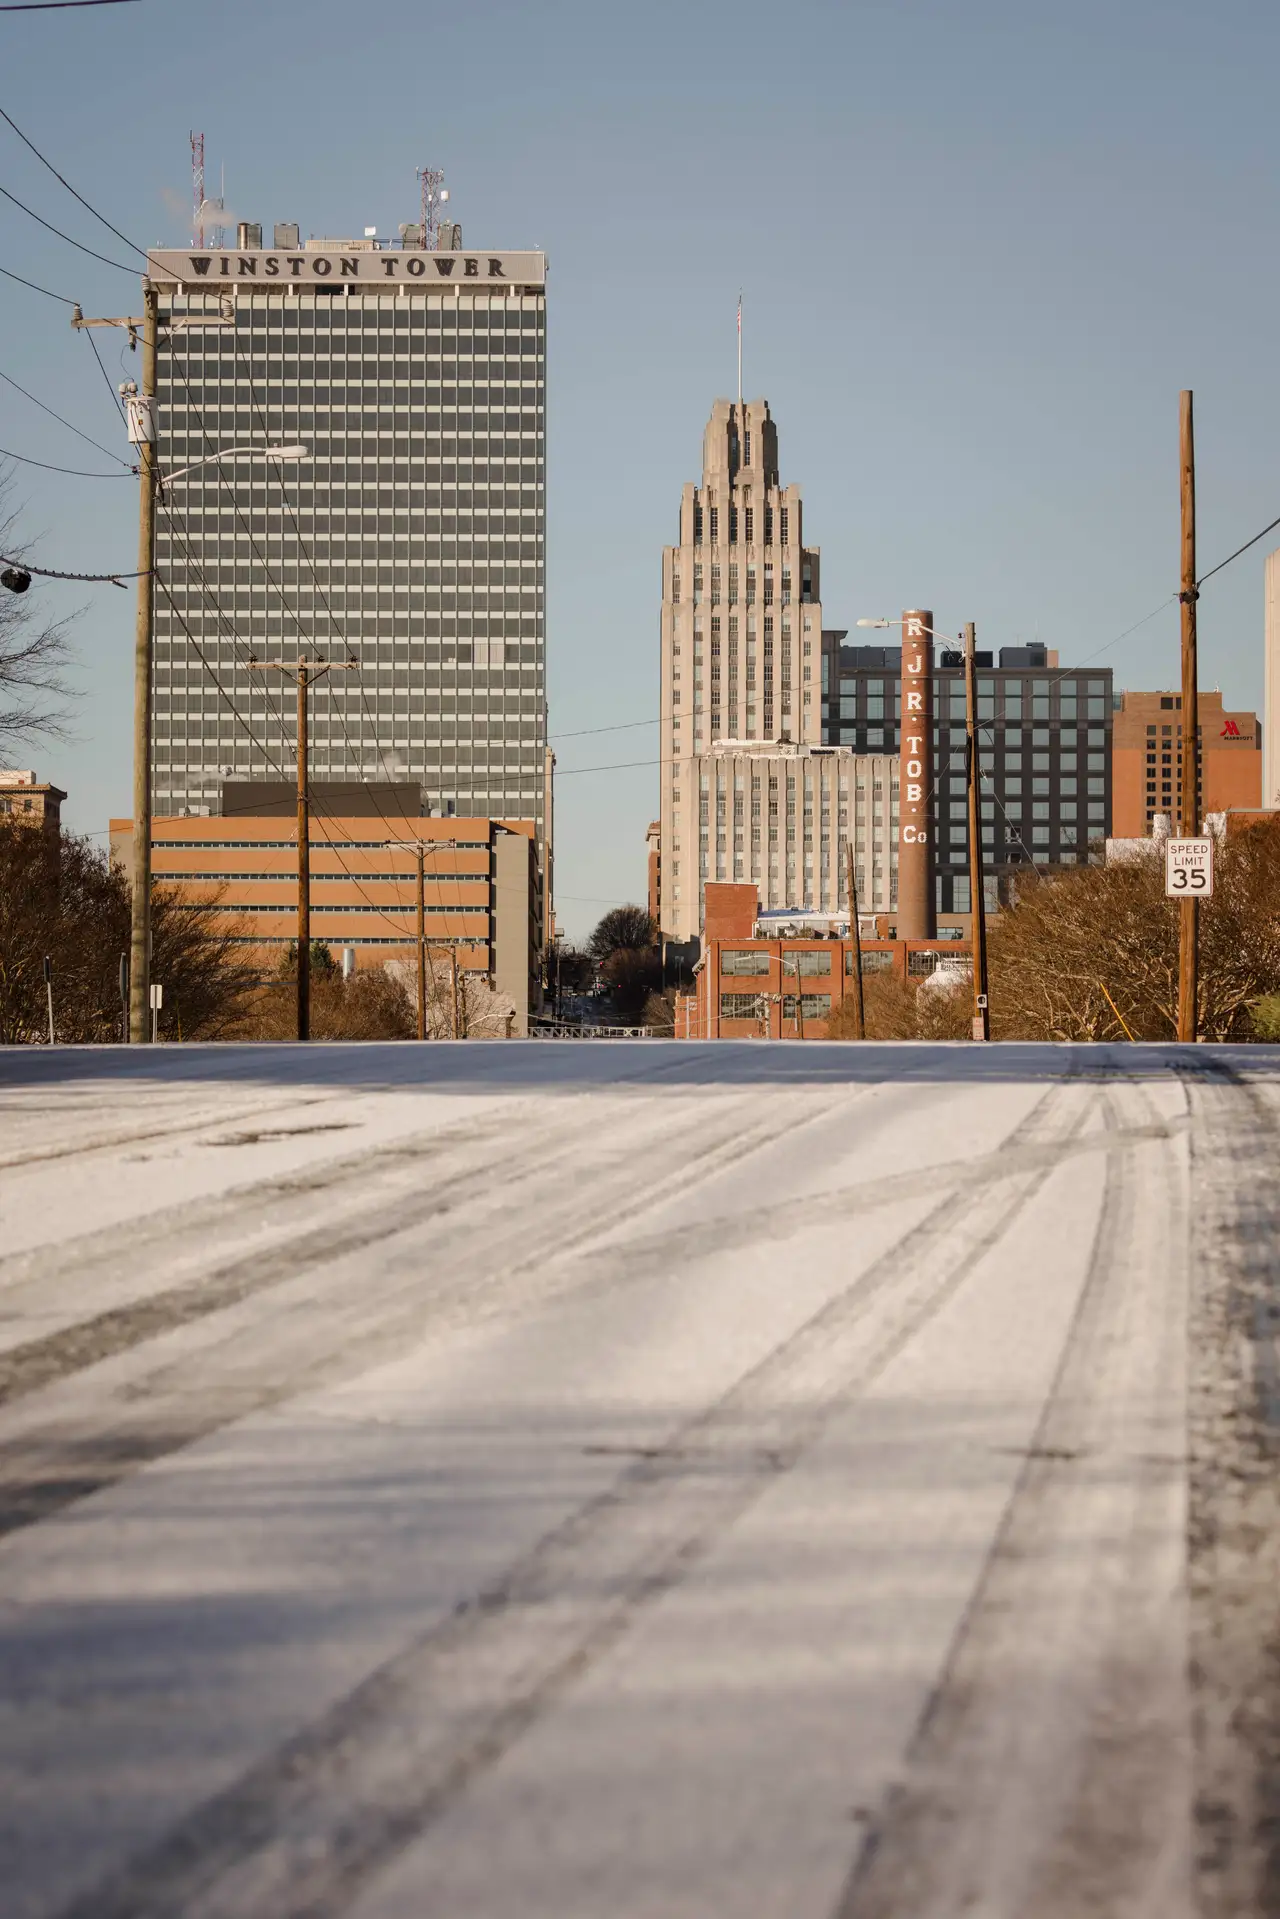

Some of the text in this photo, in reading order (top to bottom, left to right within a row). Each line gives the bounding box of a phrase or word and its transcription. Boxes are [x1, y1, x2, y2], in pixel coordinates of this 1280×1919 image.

[188, 256, 507, 277] WINSTON TOWER
[1170, 845, 1208, 854] SPEED
[1174, 857, 1204, 866] LIMIT
[1172, 868, 1207, 889] 35
